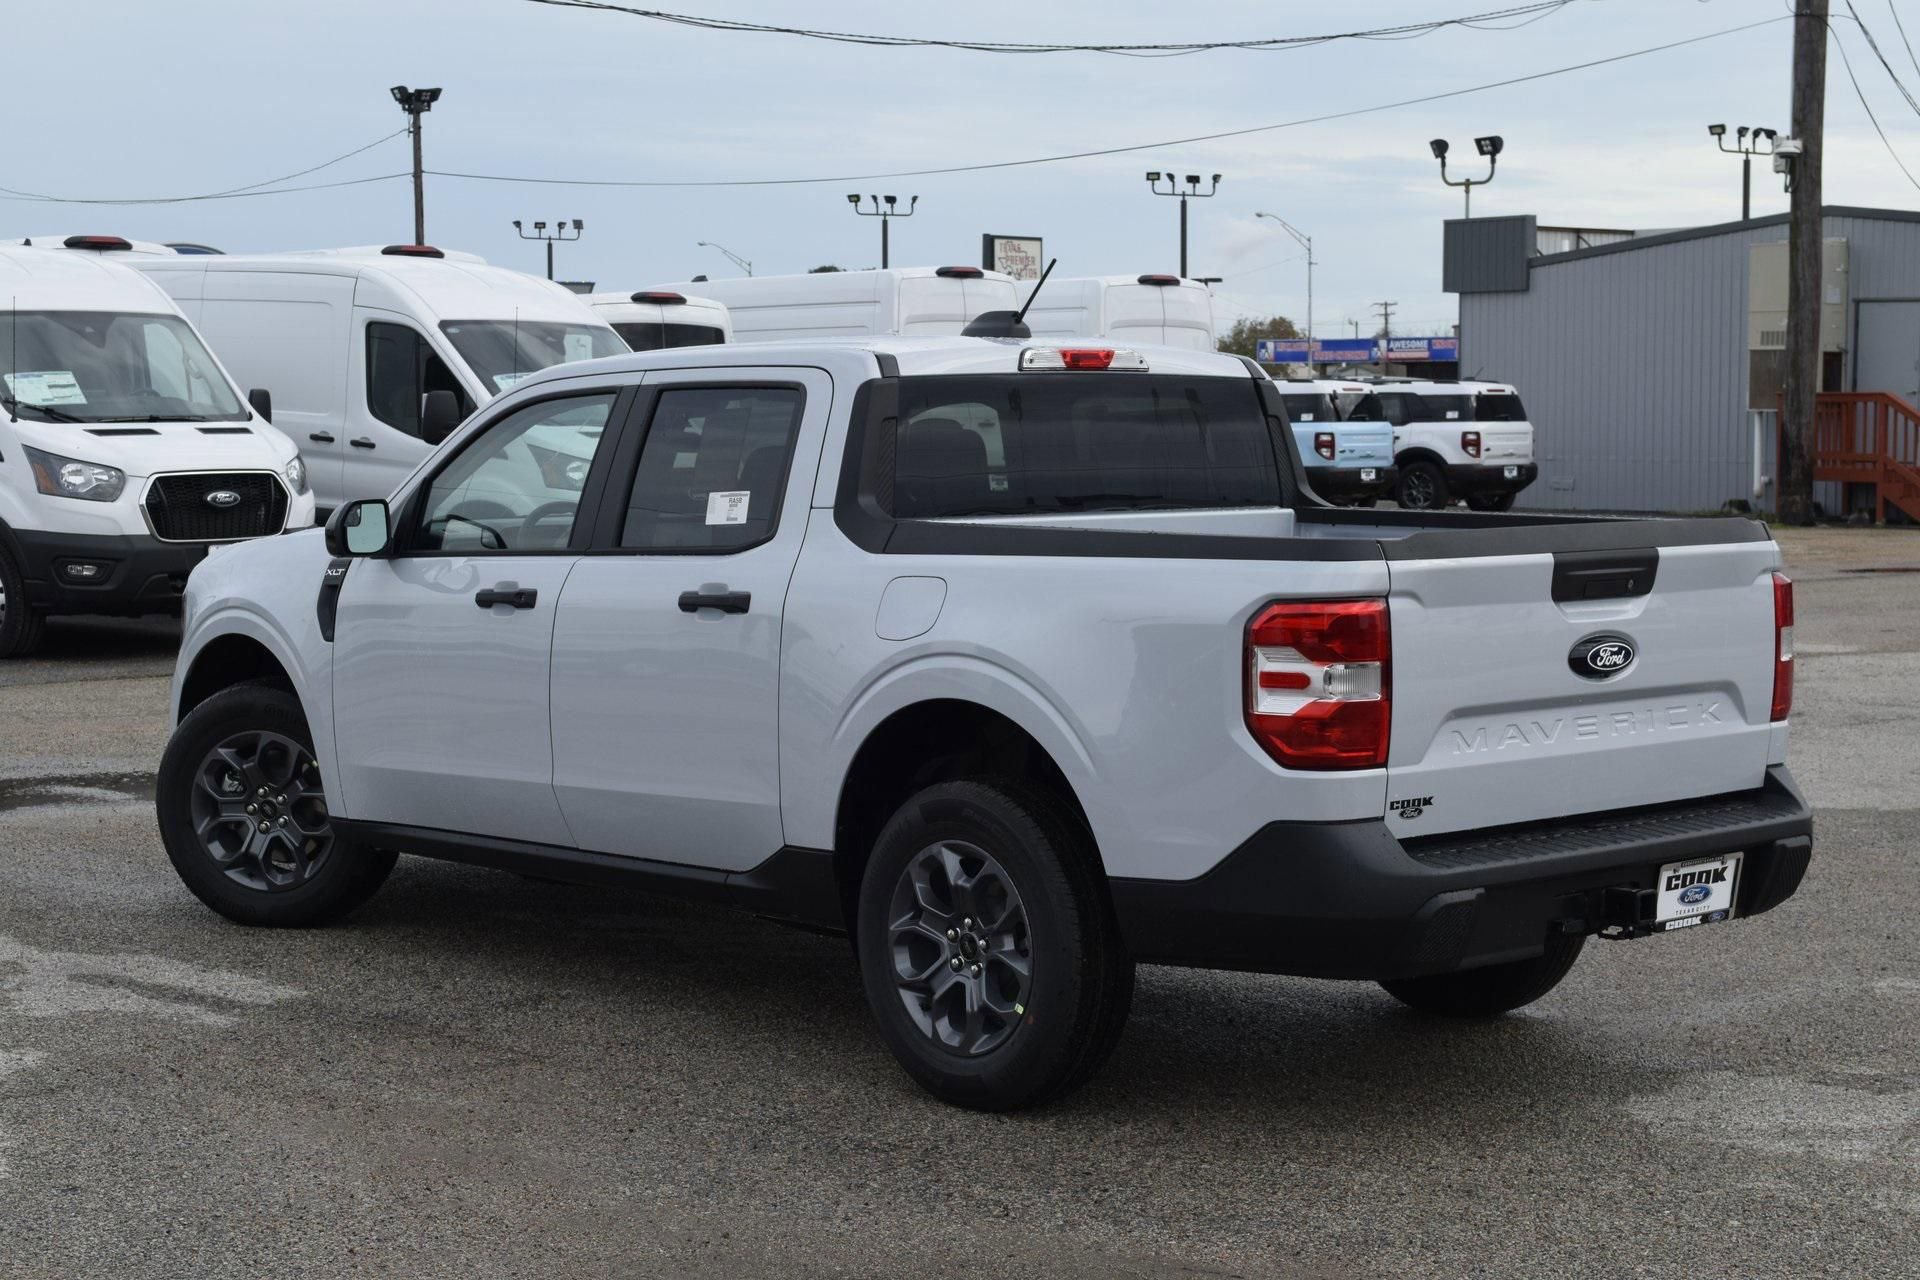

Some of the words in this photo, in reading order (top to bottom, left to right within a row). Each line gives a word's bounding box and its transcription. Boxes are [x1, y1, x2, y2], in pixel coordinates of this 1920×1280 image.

[1388, 340, 1429, 350] AWESOME
[325, 568, 345, 576] XLT
[1596, 646, 1625, 667] Ford
[1451, 702, 1722, 754] MAVERICK
[1389, 796, 1434, 811] COOK
[1665, 866, 1729, 892] COOK
[1684, 888, 1706, 902] Ford
[1665, 916, 1702, 931] COOK
